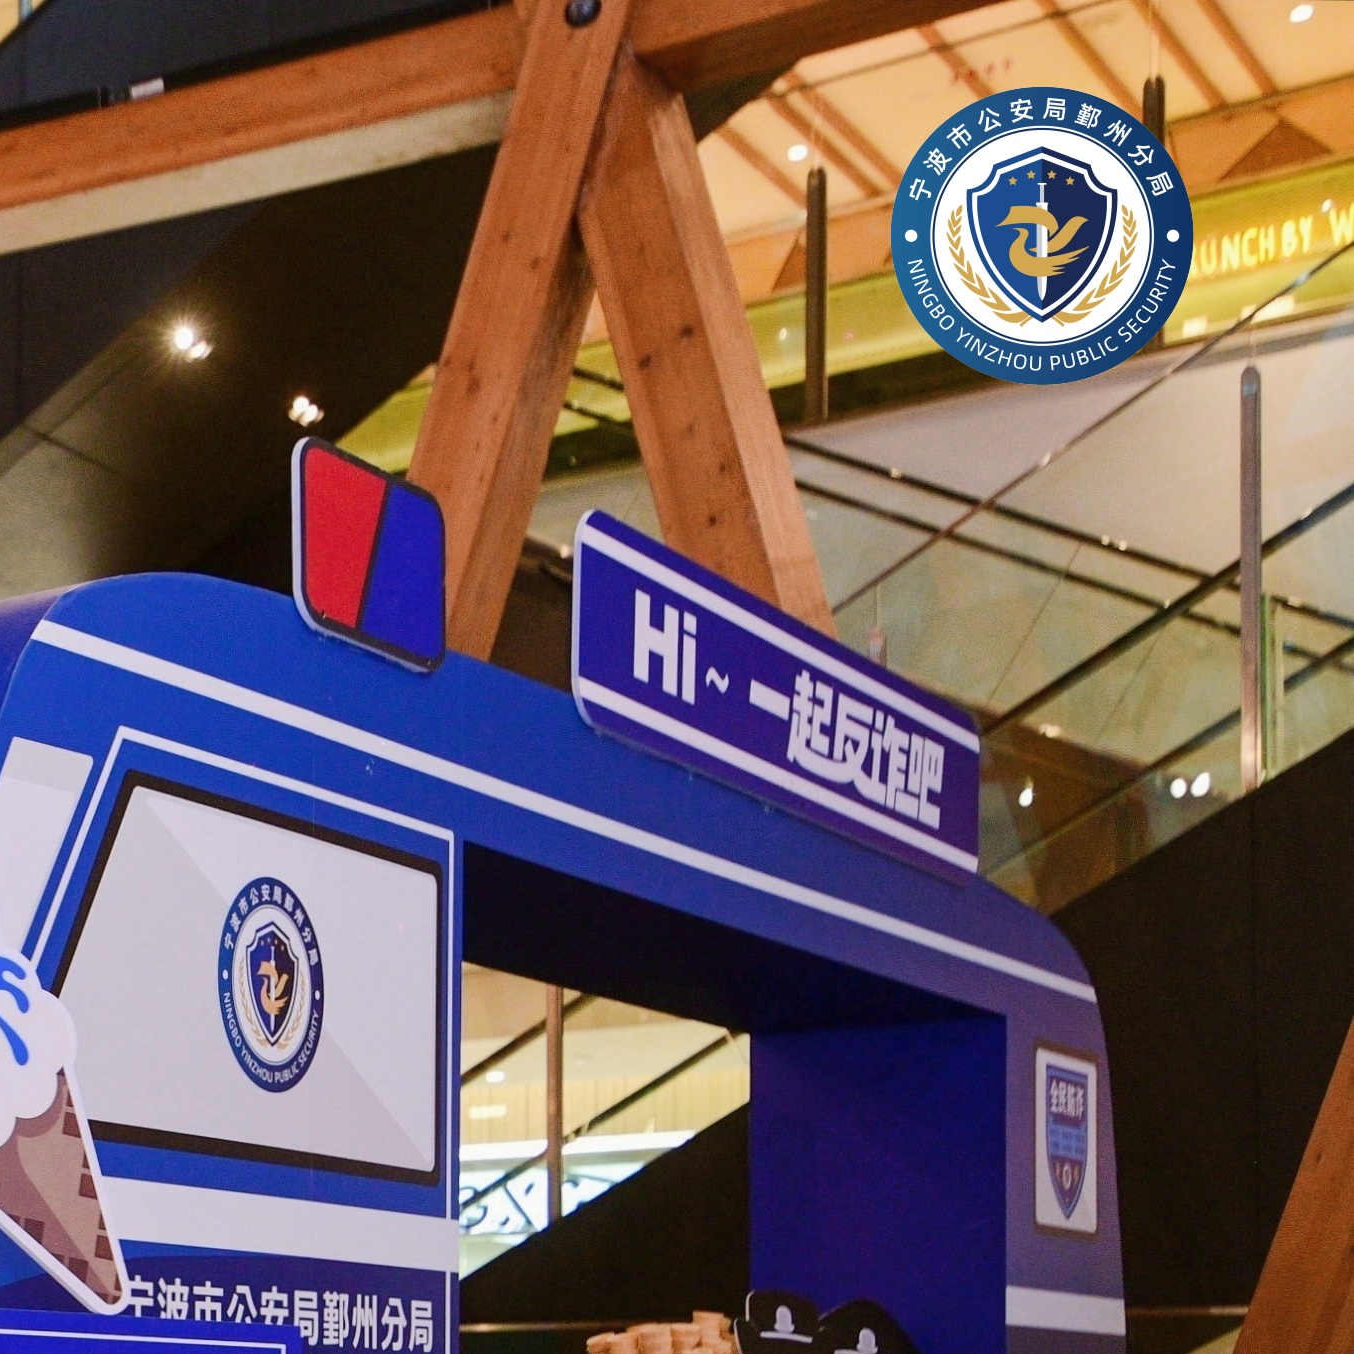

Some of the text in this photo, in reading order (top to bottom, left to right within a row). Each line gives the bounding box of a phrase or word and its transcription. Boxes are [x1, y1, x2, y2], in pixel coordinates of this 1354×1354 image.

[1281, 215, 1313, 258] BY
[749, 669, 946, 831] 一起反诈吧
[223, 992, 242, 1048] NINGBO
[274, 1064, 300, 1084] PUBLIC
[298, 1012, 319, 1068] SECURITY
[128, 1275, 434, 1353] 宁波市公安局鄞州分局
